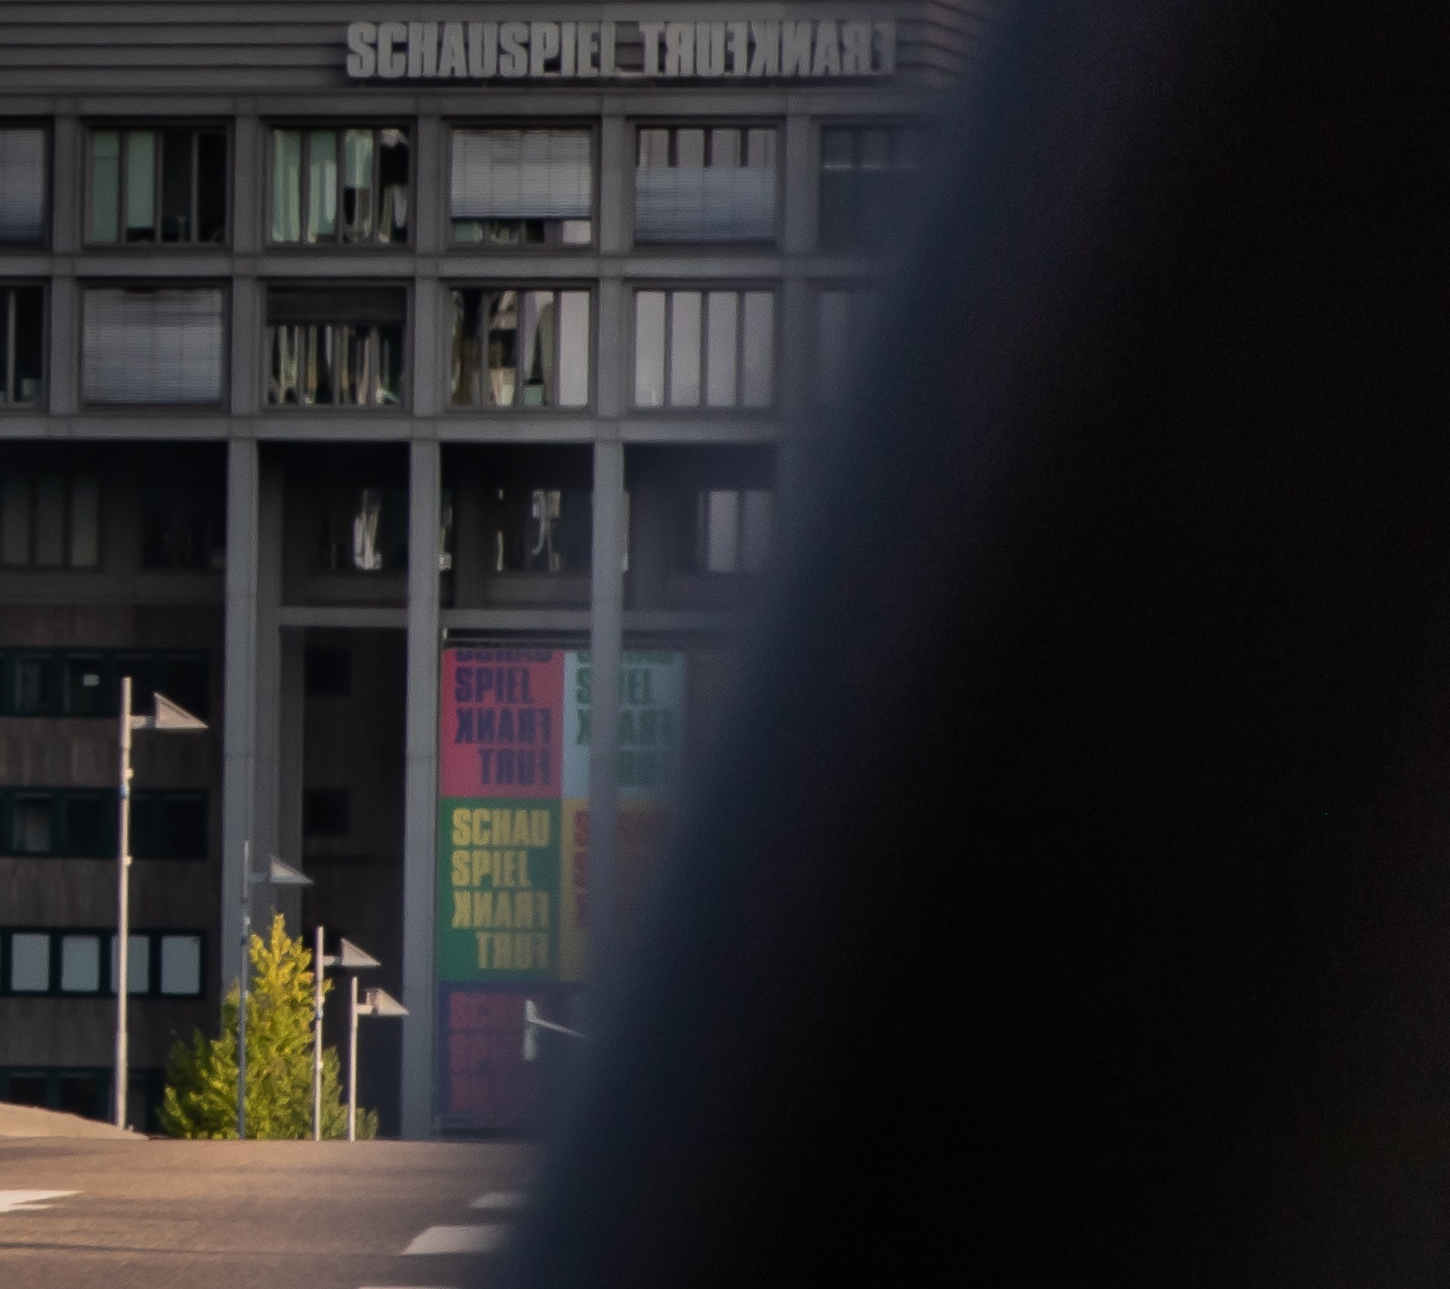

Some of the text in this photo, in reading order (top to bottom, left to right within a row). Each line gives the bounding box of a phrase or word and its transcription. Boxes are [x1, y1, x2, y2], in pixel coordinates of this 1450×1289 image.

[346, 22, 616, 78] SCHAUSPIEL
[455, 667, 534, 704] SPIEL
[576, 667, 654, 704] SIEL
[452, 808, 549, 847] SCHAU
[452, 850, 532, 888] SPIEL
